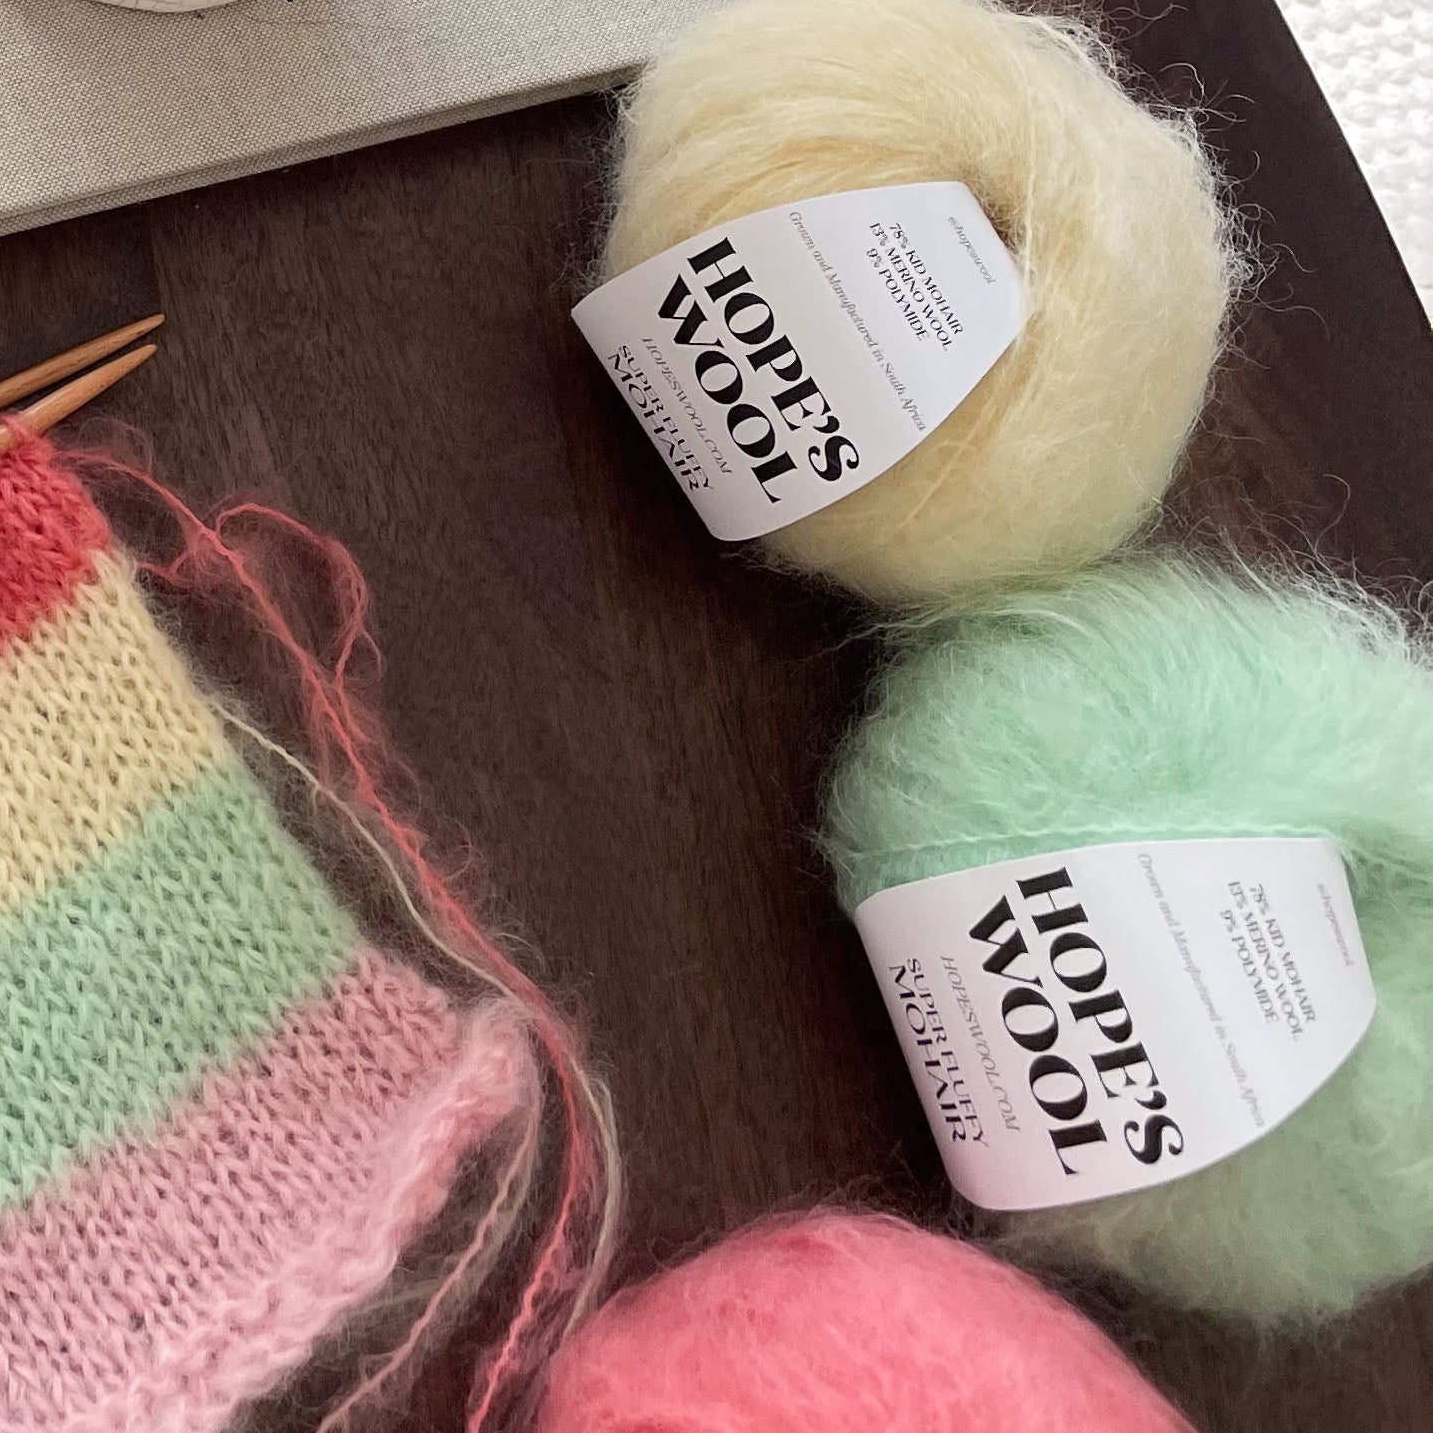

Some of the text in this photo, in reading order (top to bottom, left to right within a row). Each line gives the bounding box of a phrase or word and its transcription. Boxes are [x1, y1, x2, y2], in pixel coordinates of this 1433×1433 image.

[788, 211, 927, 432] Grown and Manufactured in South Africa
[866, 247, 929, 342] 9% POLYMIDE
[869, 222, 954, 352] 13% MERINO WOOL
[889, 222, 964, 335] 78% KID MOHAIR
[607, 353, 700, 492] MOHAIR
[618, 345, 714, 492] SUPER FLUFFY
[641, 338, 733, 474] HOPESWOOL.COM
[657, 273, 798, 504] WOOL
[686, 236, 860, 482] HOPE'S
[939, 955, 1021, 1132] HOPESWOOL.COM
[968, 894, 1108, 1176] WOOL
[1015, 866, 1185, 1165] HOPE'S
[1230, 933, 1280, 1026] POLYMIDE
[1243, 911, 1279, 981] MERINO
[1271, 982, 1307, 1042] WOOL
[1264, 918, 1285, 949] KID
[1280, 951, 1316, 1023] MOHAIR
[888, 965, 967, 1143] MOHAIR
[907, 958, 990, 1151] SUPER FLUFFY
